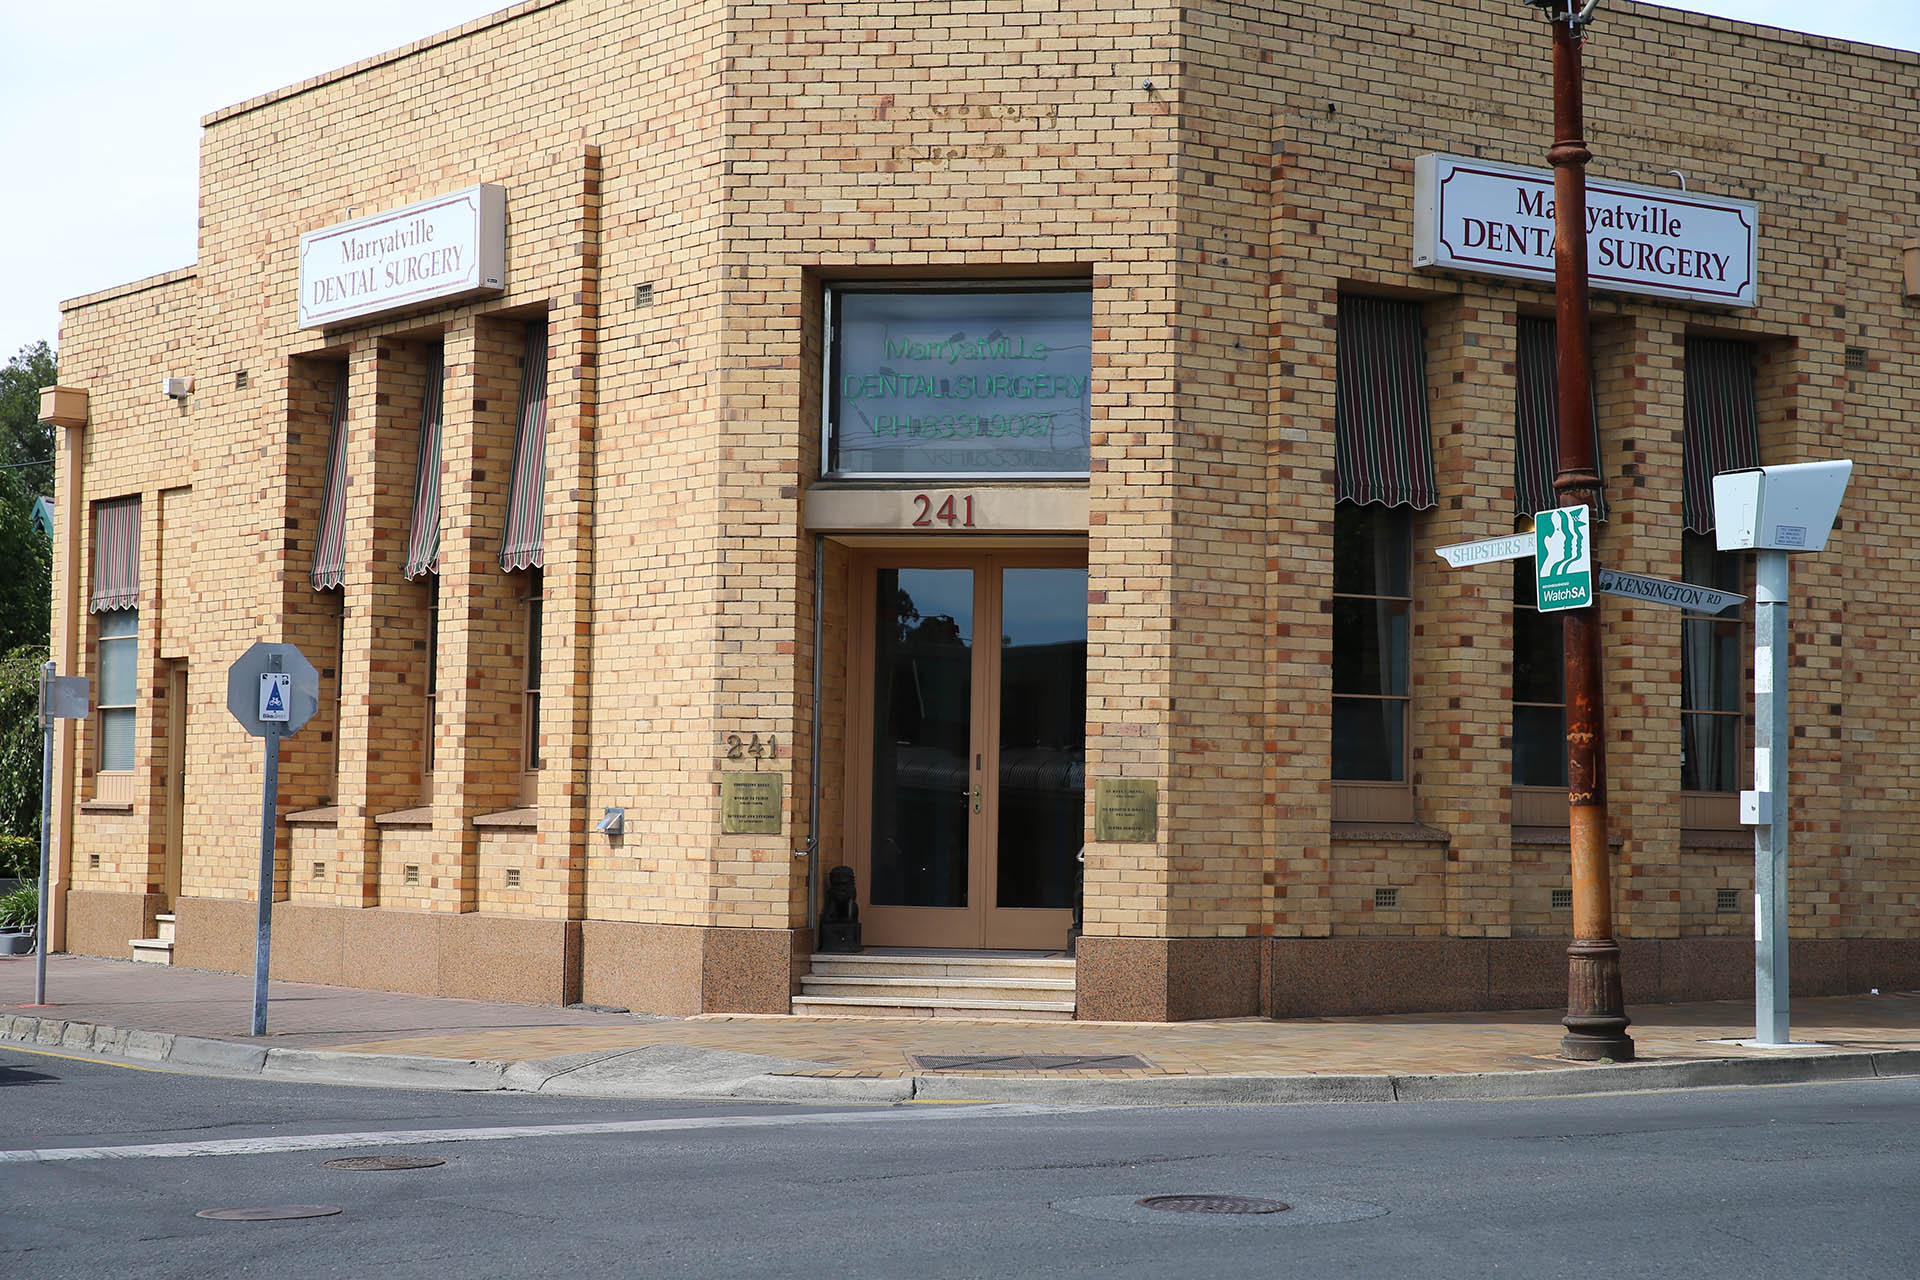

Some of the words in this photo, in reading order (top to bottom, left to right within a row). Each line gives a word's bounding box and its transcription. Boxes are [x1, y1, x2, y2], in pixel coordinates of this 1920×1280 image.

[1515, 187, 1682, 238] Mayatville
[341, 218, 434, 264] Marryatville
[1462, 217, 1556, 259] DENT
[1598, 237, 1731, 282] SURGERY
[313, 266, 378, 305] DENTAL
[384, 244, 464, 289] SURGERY
[884, 335, 1048, 365] Marryatville
[844, 373, 943, 399] DENTAL
[953, 373, 1088, 399] SURGERY
[872, 412, 912, 438] PH
[919, 412, 981, 439] 8331
[912, 494, 976, 527] 241
[1452, 538, 1522, 564] SHIPSTERS
[1543, 586, 1586, 602] WatchSA
[1614, 576, 1704, 605] KENSINGTON
[1706, 593, 1722, 605] RD
[726, 734, 777, 759] 241
